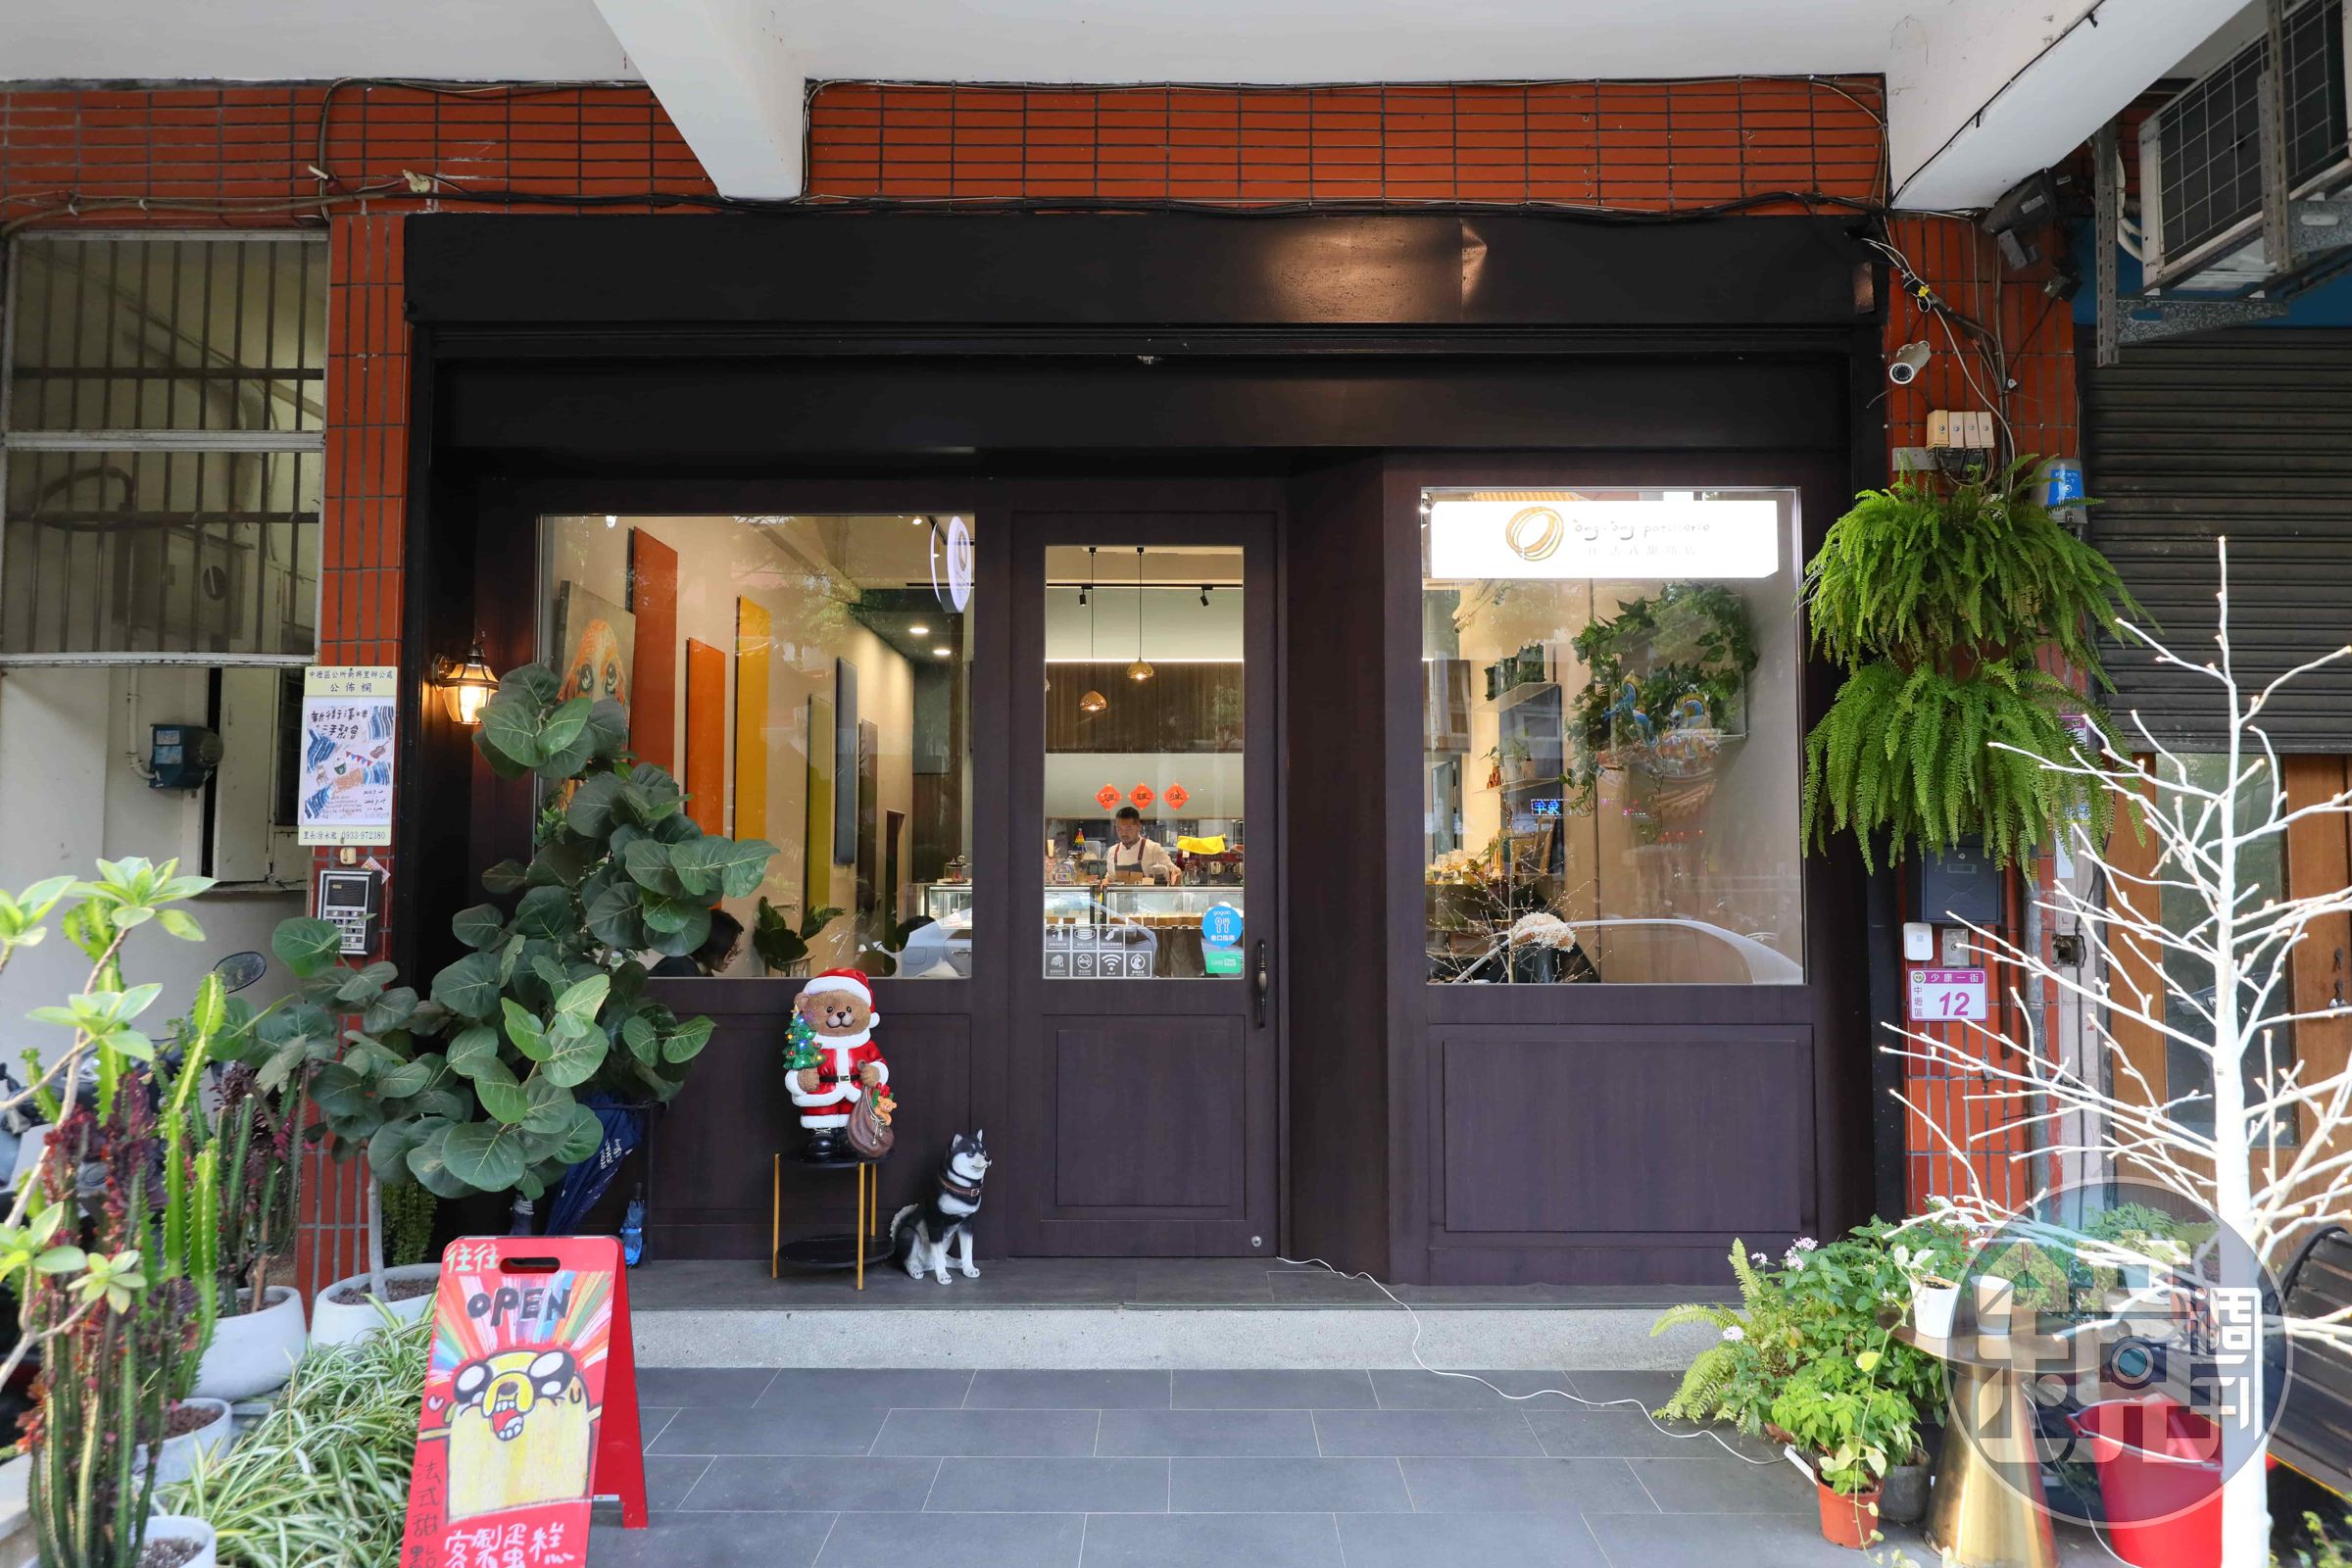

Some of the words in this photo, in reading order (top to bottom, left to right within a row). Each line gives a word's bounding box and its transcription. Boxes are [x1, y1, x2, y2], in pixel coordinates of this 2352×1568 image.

[1931, 972, 1980, 983] 少康一街
[1914, 986, 1923, 1017] 中壢區
[1939, 991, 1970, 1016] 12
[445, 1243, 499, 1274] 往往
[466, 1286, 572, 1327] OPEN
[444, 1522, 575, 1568] 客製蛋糕
